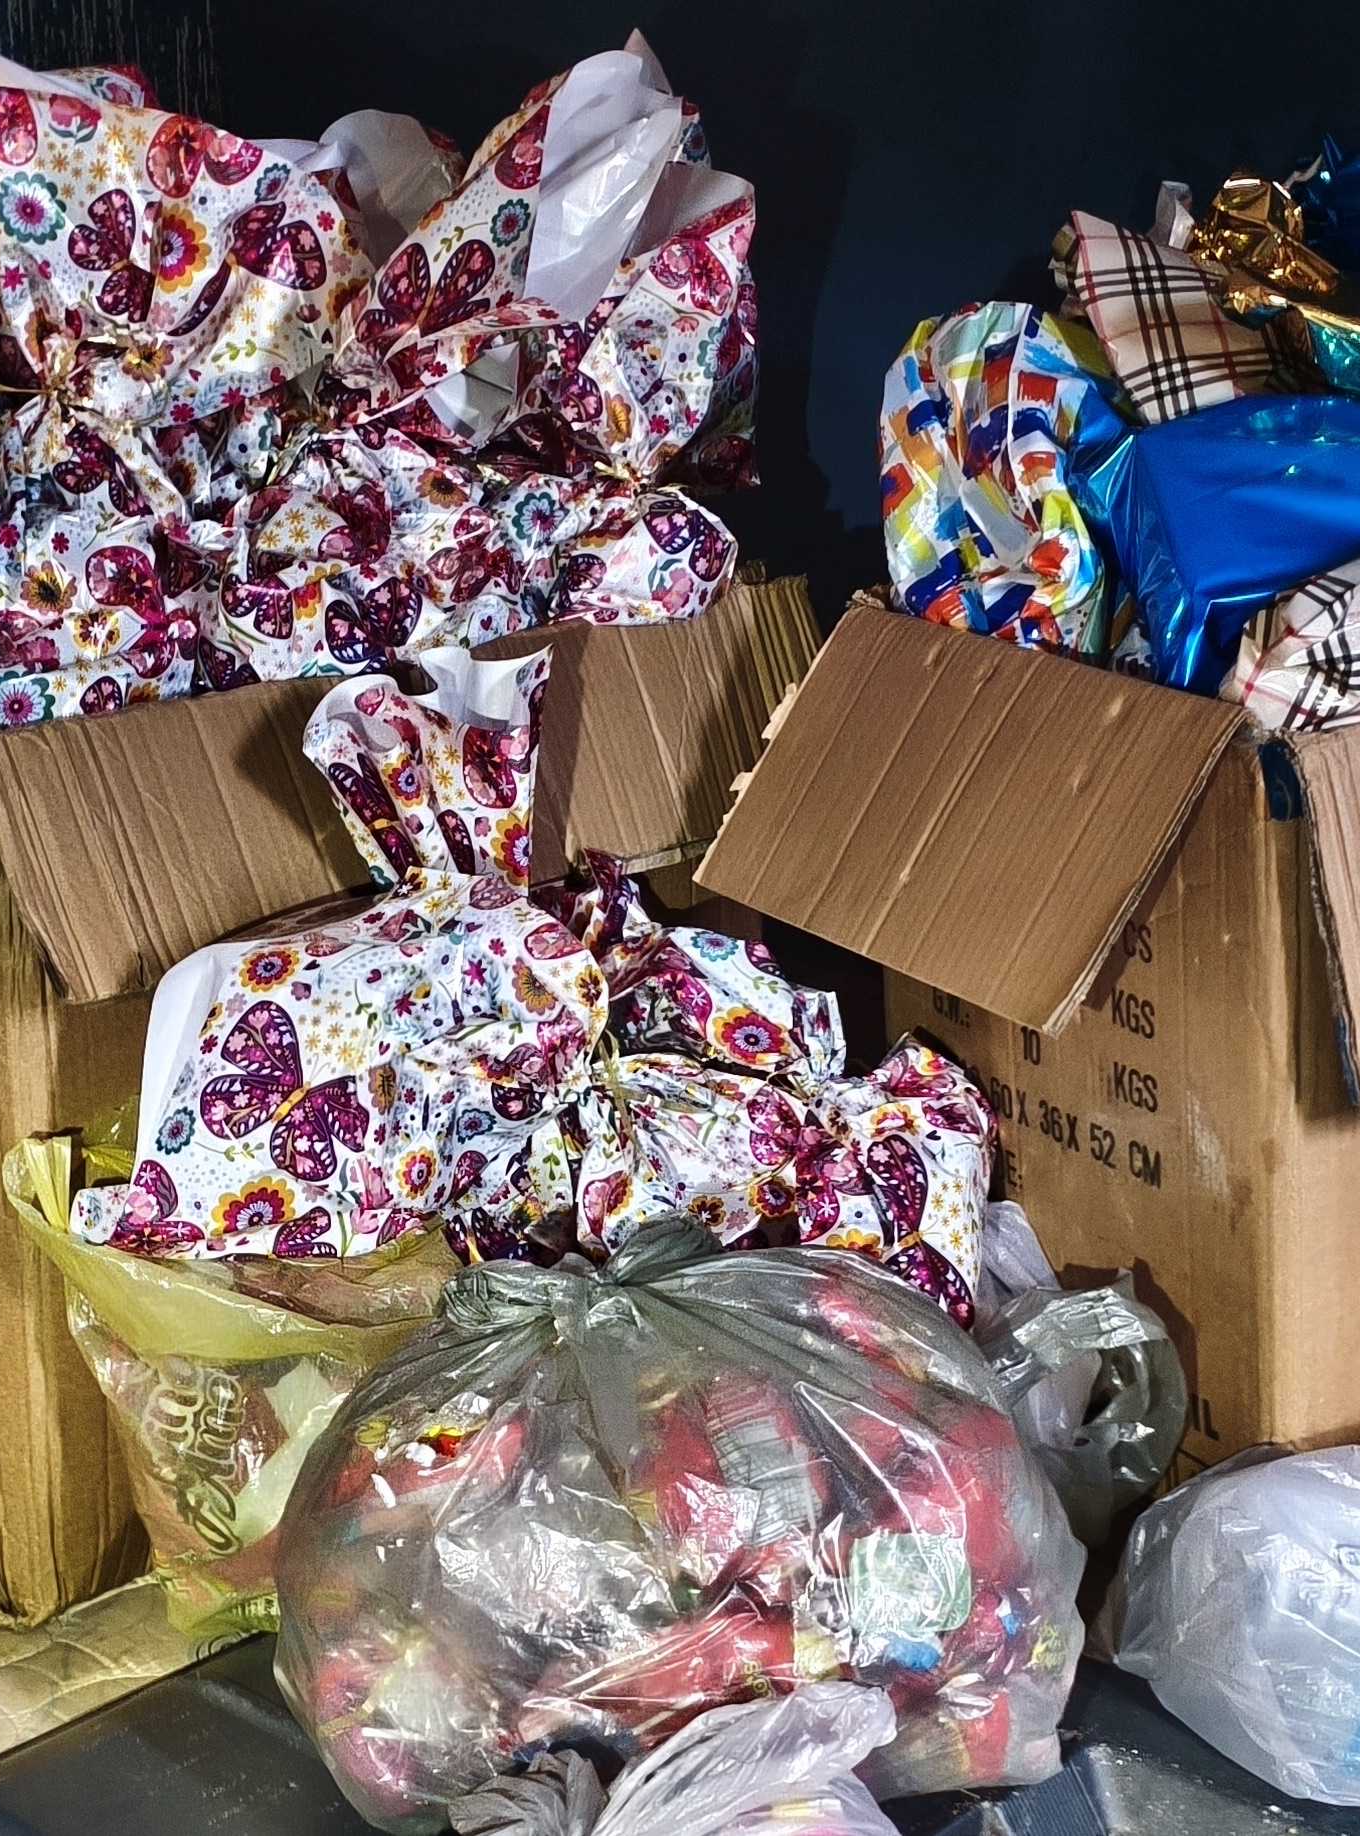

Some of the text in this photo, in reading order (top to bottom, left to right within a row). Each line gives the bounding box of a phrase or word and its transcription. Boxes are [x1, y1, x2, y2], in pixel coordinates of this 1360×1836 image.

[1122, 919, 1153, 964] CS
[1111, 987, 1156, 1040] KGS
[1020, 1025, 1041, 1066] 10
[1113, 1061, 1159, 1114] KGS
